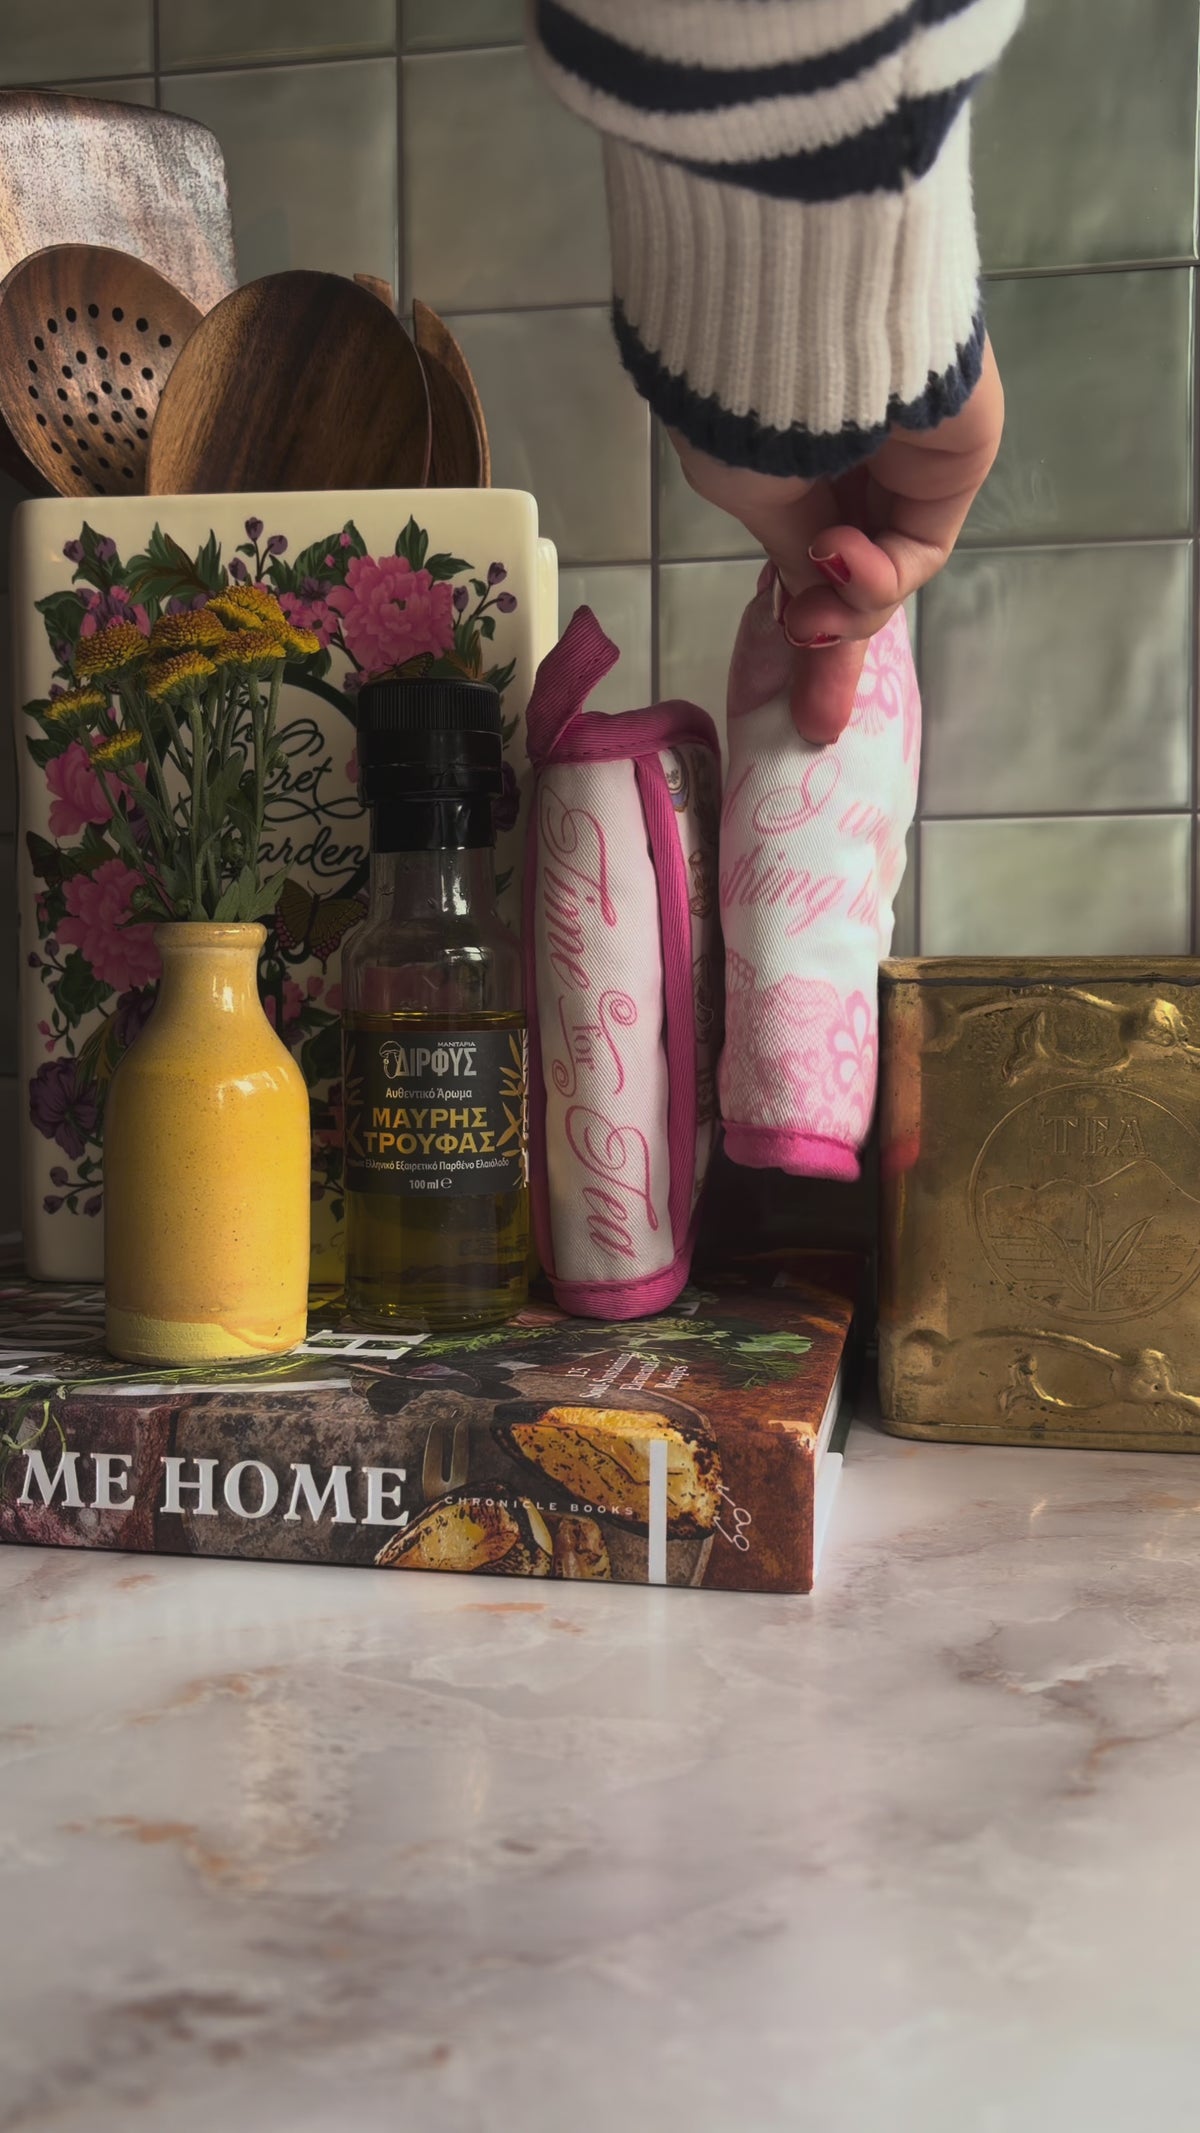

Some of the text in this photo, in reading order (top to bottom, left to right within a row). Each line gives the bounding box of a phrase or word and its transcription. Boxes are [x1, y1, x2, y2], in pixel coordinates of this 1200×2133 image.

[540, 786, 618, 991] Time
[396, 1047, 478, 1077] ΔΙΡΦΥΣ
[386, 1087, 436, 1099] Αυθεντικό
[372, 1107, 488, 1129] ΜΑΥΡΗΣ
[363, 1130, 496, 1155] ΤΡΟΥΦΑΣ
[1040, 1113, 1150, 1158] TEA
[395, 1159, 438, 1172] Εξαιρετικό
[439, 1160, 475, 1172] Παρθένο
[409, 1179, 426, 1190] 100
[427, 1179, 439, 1190] ml
[565, 1105, 659, 1258] Tea
[654, 1365, 690, 1389] Recipes
[16, 1449, 410, 1527] ME HOME
[444, 1496, 635, 1517] CHRONICLE BOOKS
